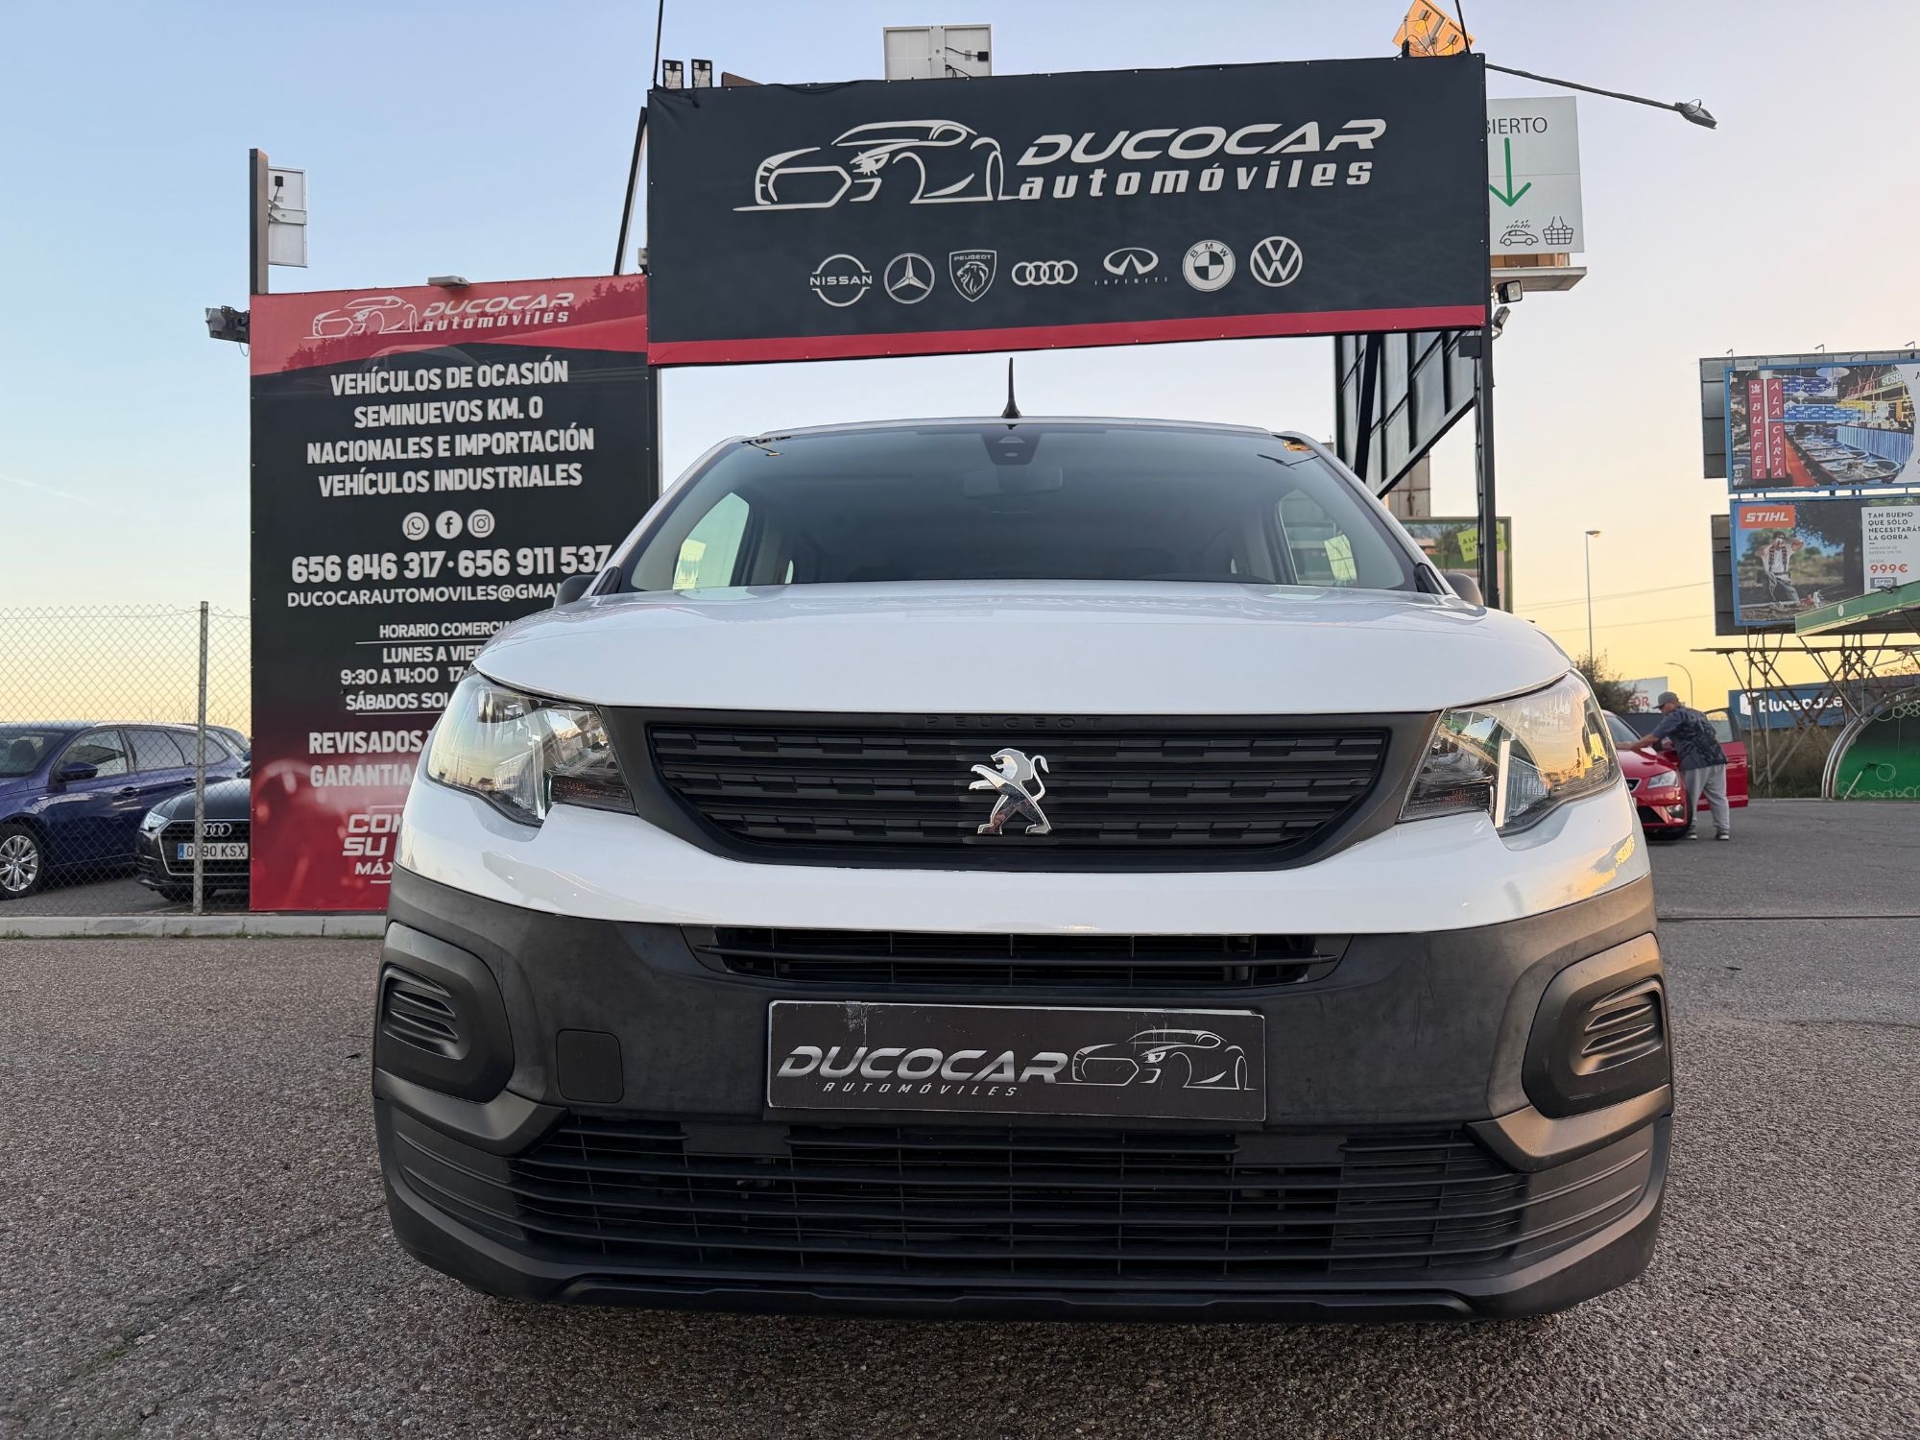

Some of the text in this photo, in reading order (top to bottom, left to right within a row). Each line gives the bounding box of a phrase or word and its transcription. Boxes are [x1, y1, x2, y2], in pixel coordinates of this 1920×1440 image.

[1016, 118, 1387, 166] DUCOCAR
[1019, 157, 1373, 200] automóviles
[810, 275, 872, 286] NISSAN
[423, 292, 574, 317] DUCOCAR
[423, 309, 569, 332] automóviles
[330, 355, 568, 396] VEHÍCULOS DE OCASIÓN
[354, 399, 482, 429] SEMINUEVOS
[487, 397, 524, 420] KM.
[307, 422, 594, 464] NACIONALES E IMPORTACIÓN
[1752, 402, 1763, 477] BUFFET
[1772, 425, 1783, 476] CARTA
[319, 463, 582, 497] VEHÍCULOS INDUSTRIALES
[1745, 512, 1789, 523] STIHL
[291, 555, 341, 583] 656
[347, 552, 398, 581] 846
[516, 546, 554, 575] 911
[560, 545, 612, 574] 537
[1870, 563, 1908, 574] 999€
[380, 623, 439, 638] HORARIO
[383, 646, 433, 663] LUNES
[436, 646, 448, 661] A
[340, 669, 378, 685] 9:30
[380, 669, 392, 684] A
[394, 667, 439, 684] 14:00
[345, 690, 418, 710] SÁBADOS
[925, 716, 1102, 728] PEUGEOT
[309, 730, 423, 754] REVISADOS
[310, 763, 413, 787] GARANTIA
[186, 845, 246, 857] 090 KSX
[343, 837, 387, 856] SU
[776, 1045, 1068, 1084] DUCOCAR
[823, 1081, 1017, 1097] AUTOMÓVILES
